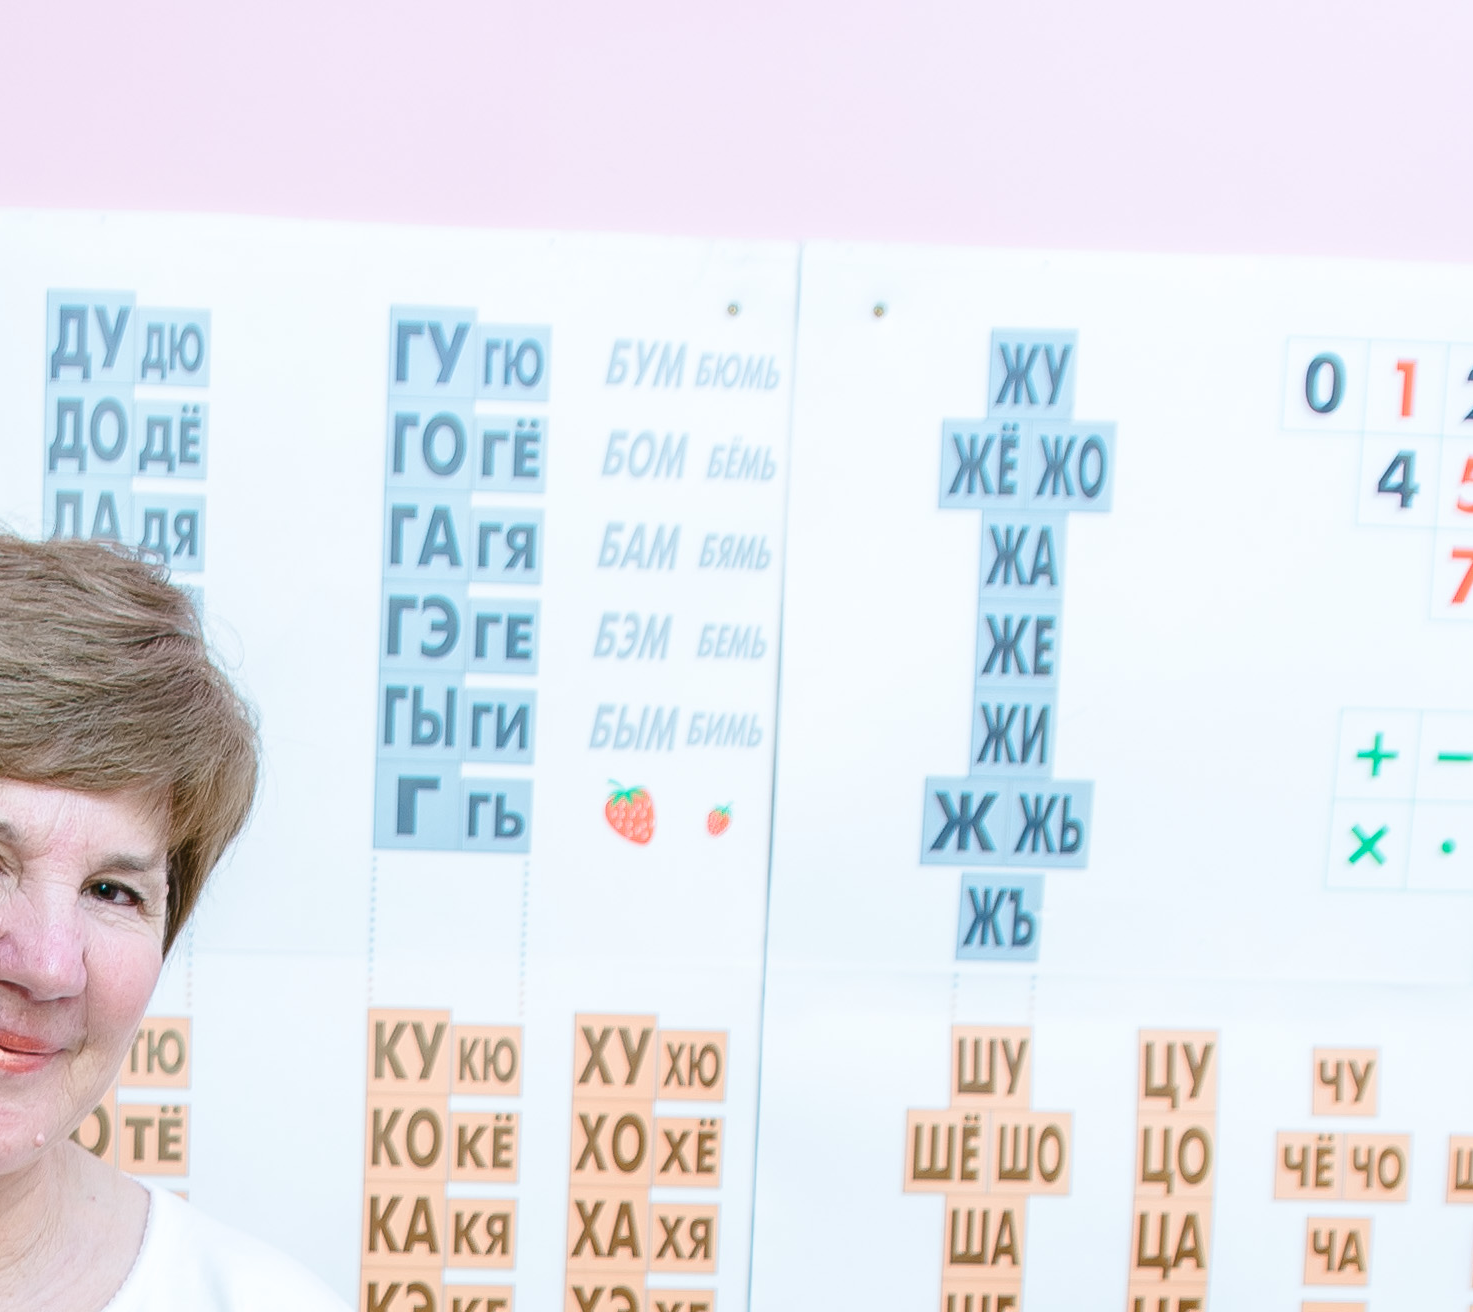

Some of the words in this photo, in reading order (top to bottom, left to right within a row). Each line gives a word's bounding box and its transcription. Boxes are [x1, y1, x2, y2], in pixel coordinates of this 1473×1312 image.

[49, 304, 130, 383] ДУ
[140, 323, 205, 381] ДЮ
[394, 320, 470, 385] ГУ
[483, 339, 544, 388] ГЮ
[604, 339, 687, 389] БУМ
[694, 352, 780, 391] БЮМЬ
[1304, 356, 1342, 415] 0
[1396, 360, 1416, 418] 1
[947, 423, 1019, 496] ЖЁ
[1035, 436, 1106, 499] ЖО
[577, 1026, 652, 1086] ХУ
[663, 1043, 721, 1089] ХЮ
